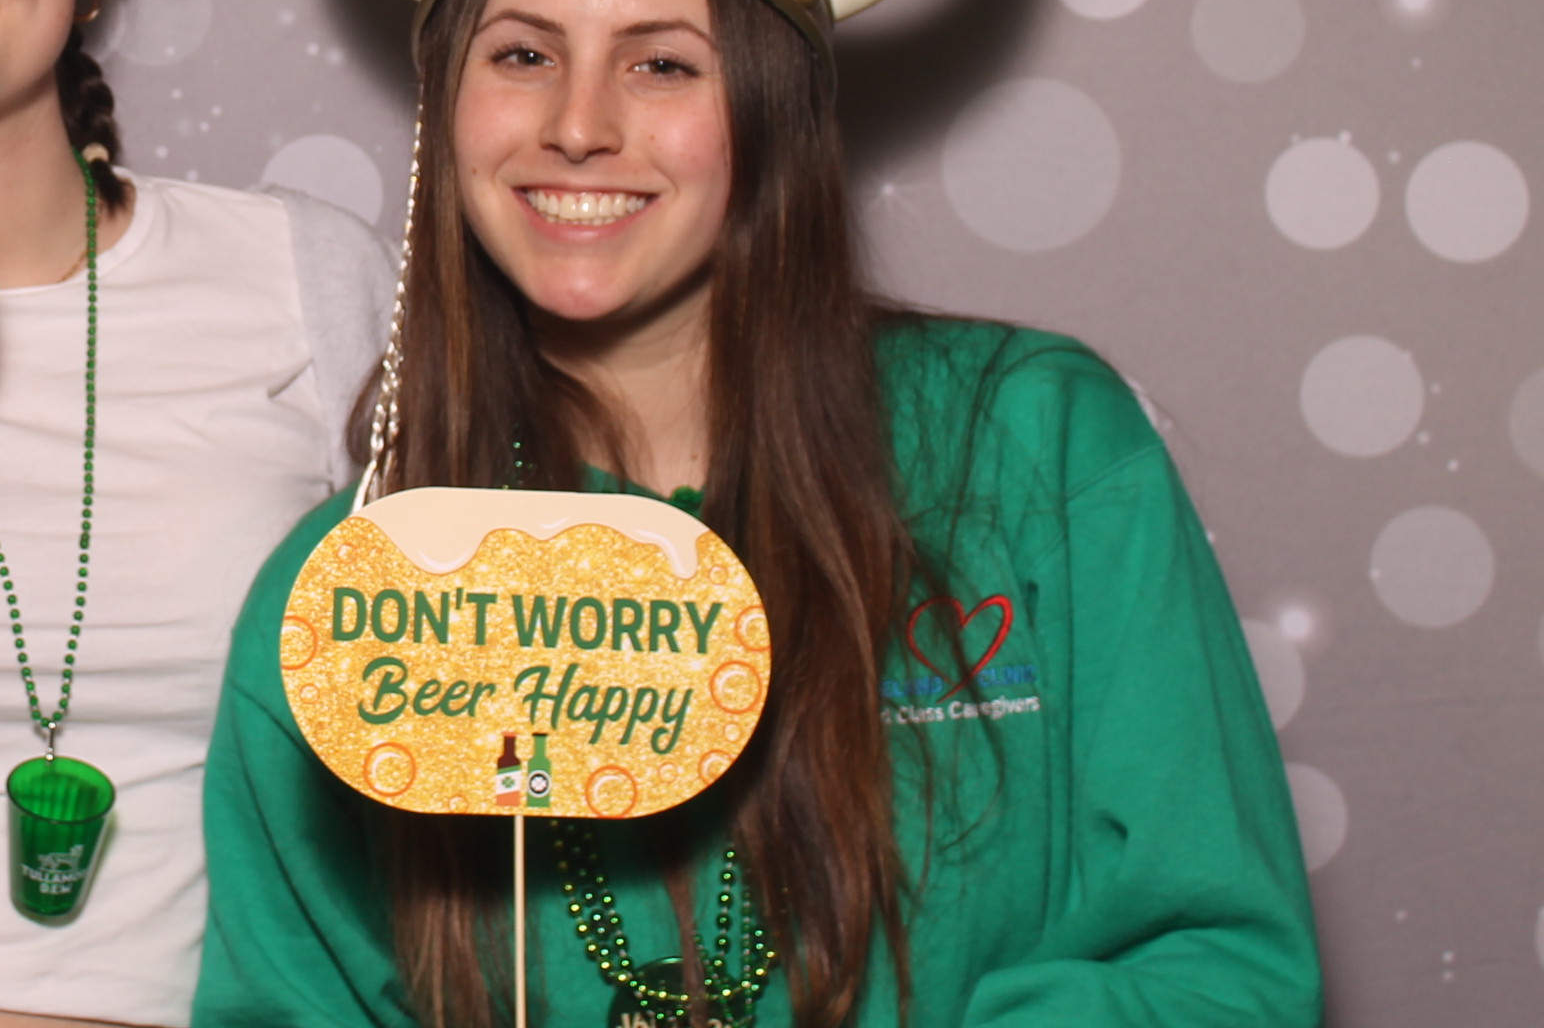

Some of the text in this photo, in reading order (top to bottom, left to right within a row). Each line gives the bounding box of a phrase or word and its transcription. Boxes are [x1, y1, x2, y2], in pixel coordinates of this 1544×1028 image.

[331, 586, 722, 654] DON'T WORRY
[357, 656, 693, 755] Beer Happy
[895, 705, 945, 724] Class
[948, 695, 1040, 720] Caregivers
